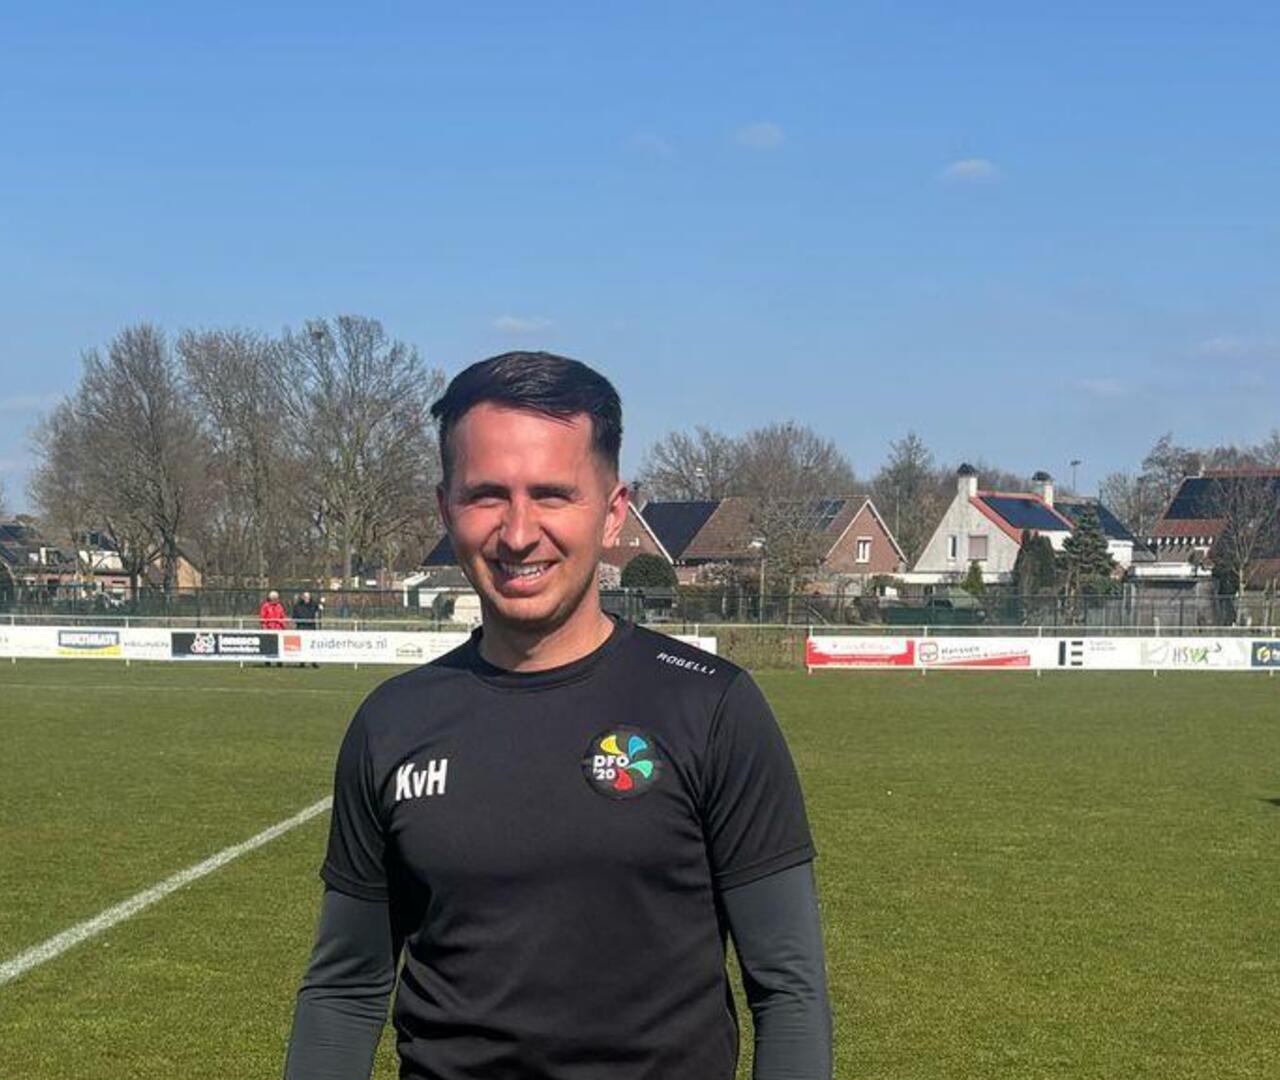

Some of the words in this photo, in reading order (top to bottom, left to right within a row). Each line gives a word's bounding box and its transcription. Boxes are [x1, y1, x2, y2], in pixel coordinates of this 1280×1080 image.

[656, 652, 716, 675] ROGELLI
[593, 754, 630, 768] DFO
[395, 758, 448, 801] KvH
[593, 767, 617, 780] '20
